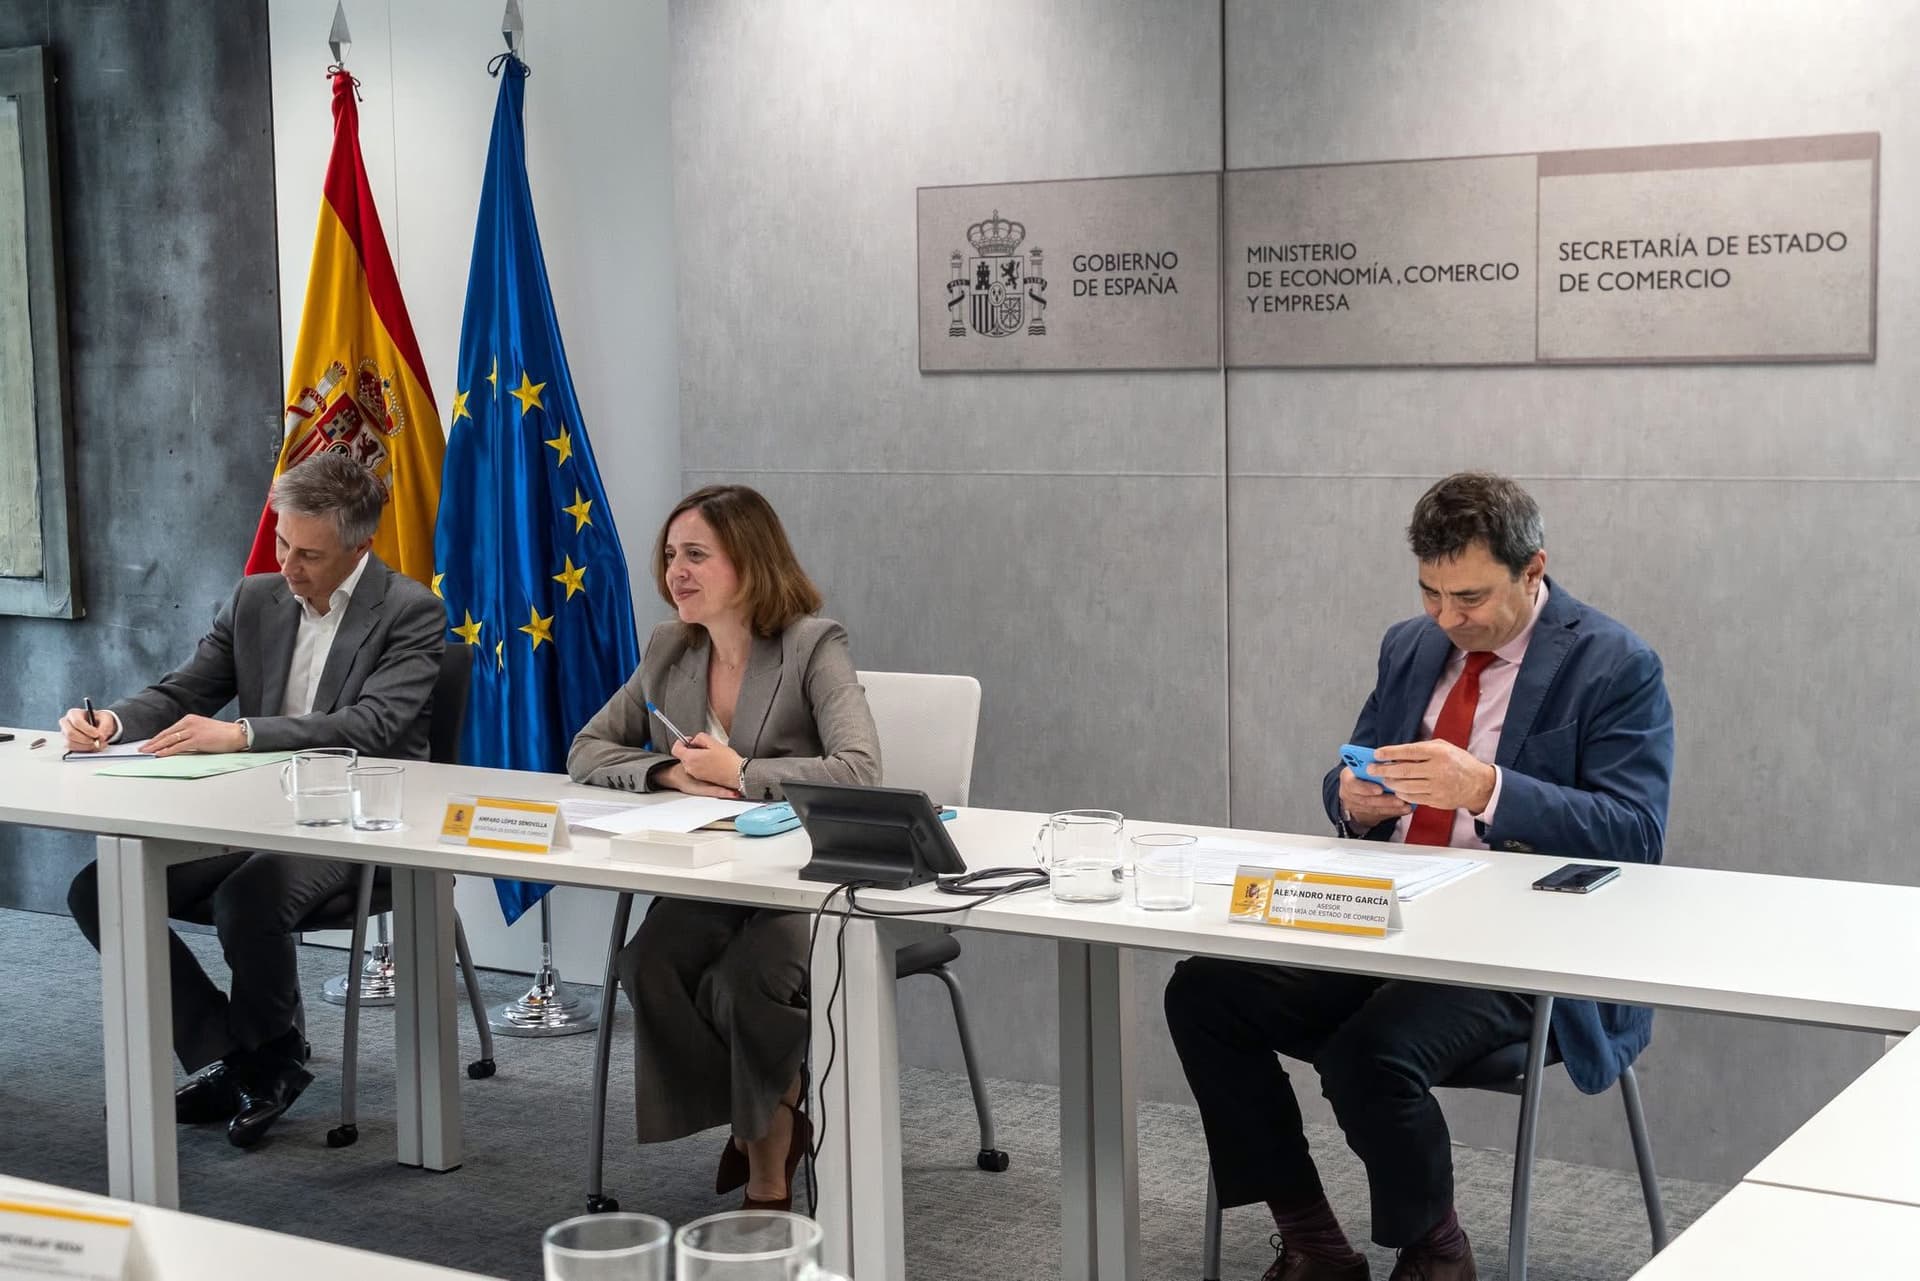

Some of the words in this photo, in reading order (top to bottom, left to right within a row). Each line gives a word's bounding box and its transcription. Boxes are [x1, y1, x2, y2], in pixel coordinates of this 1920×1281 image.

[1247, 242, 1357, 263] MINISTERIO
[1558, 233, 1698, 262] SECRETARÍA
[1707, 235, 1739, 256] DE
[1747, 231, 1848, 255] ESTADO
[1072, 251, 1178, 272] GOBIERNO
[1073, 279, 1098, 296] DE
[1104, 272, 1179, 296] ESPAÑA
[1247, 271, 1272, 288] DE
[1404, 262, 1520, 284] COMERCIO
[1559, 273, 1590, 293] DE
[1596, 268, 1731, 292] COMERCIO
[1247, 296, 1260, 313] Y
[1263, 293, 1350, 313] EMPRESA
[1317, 903, 1341, 911] ASESOR
[1325, 893, 1353, 903] NIETO
[1355, 895, 1389, 906] GARCÍA
[1308, 909, 1317, 917] DE
[1318, 910, 1342, 919] ESTADO
[1343, 912, 1352, 920] DE
[1353, 913, 1386, 923] COMERCIO
